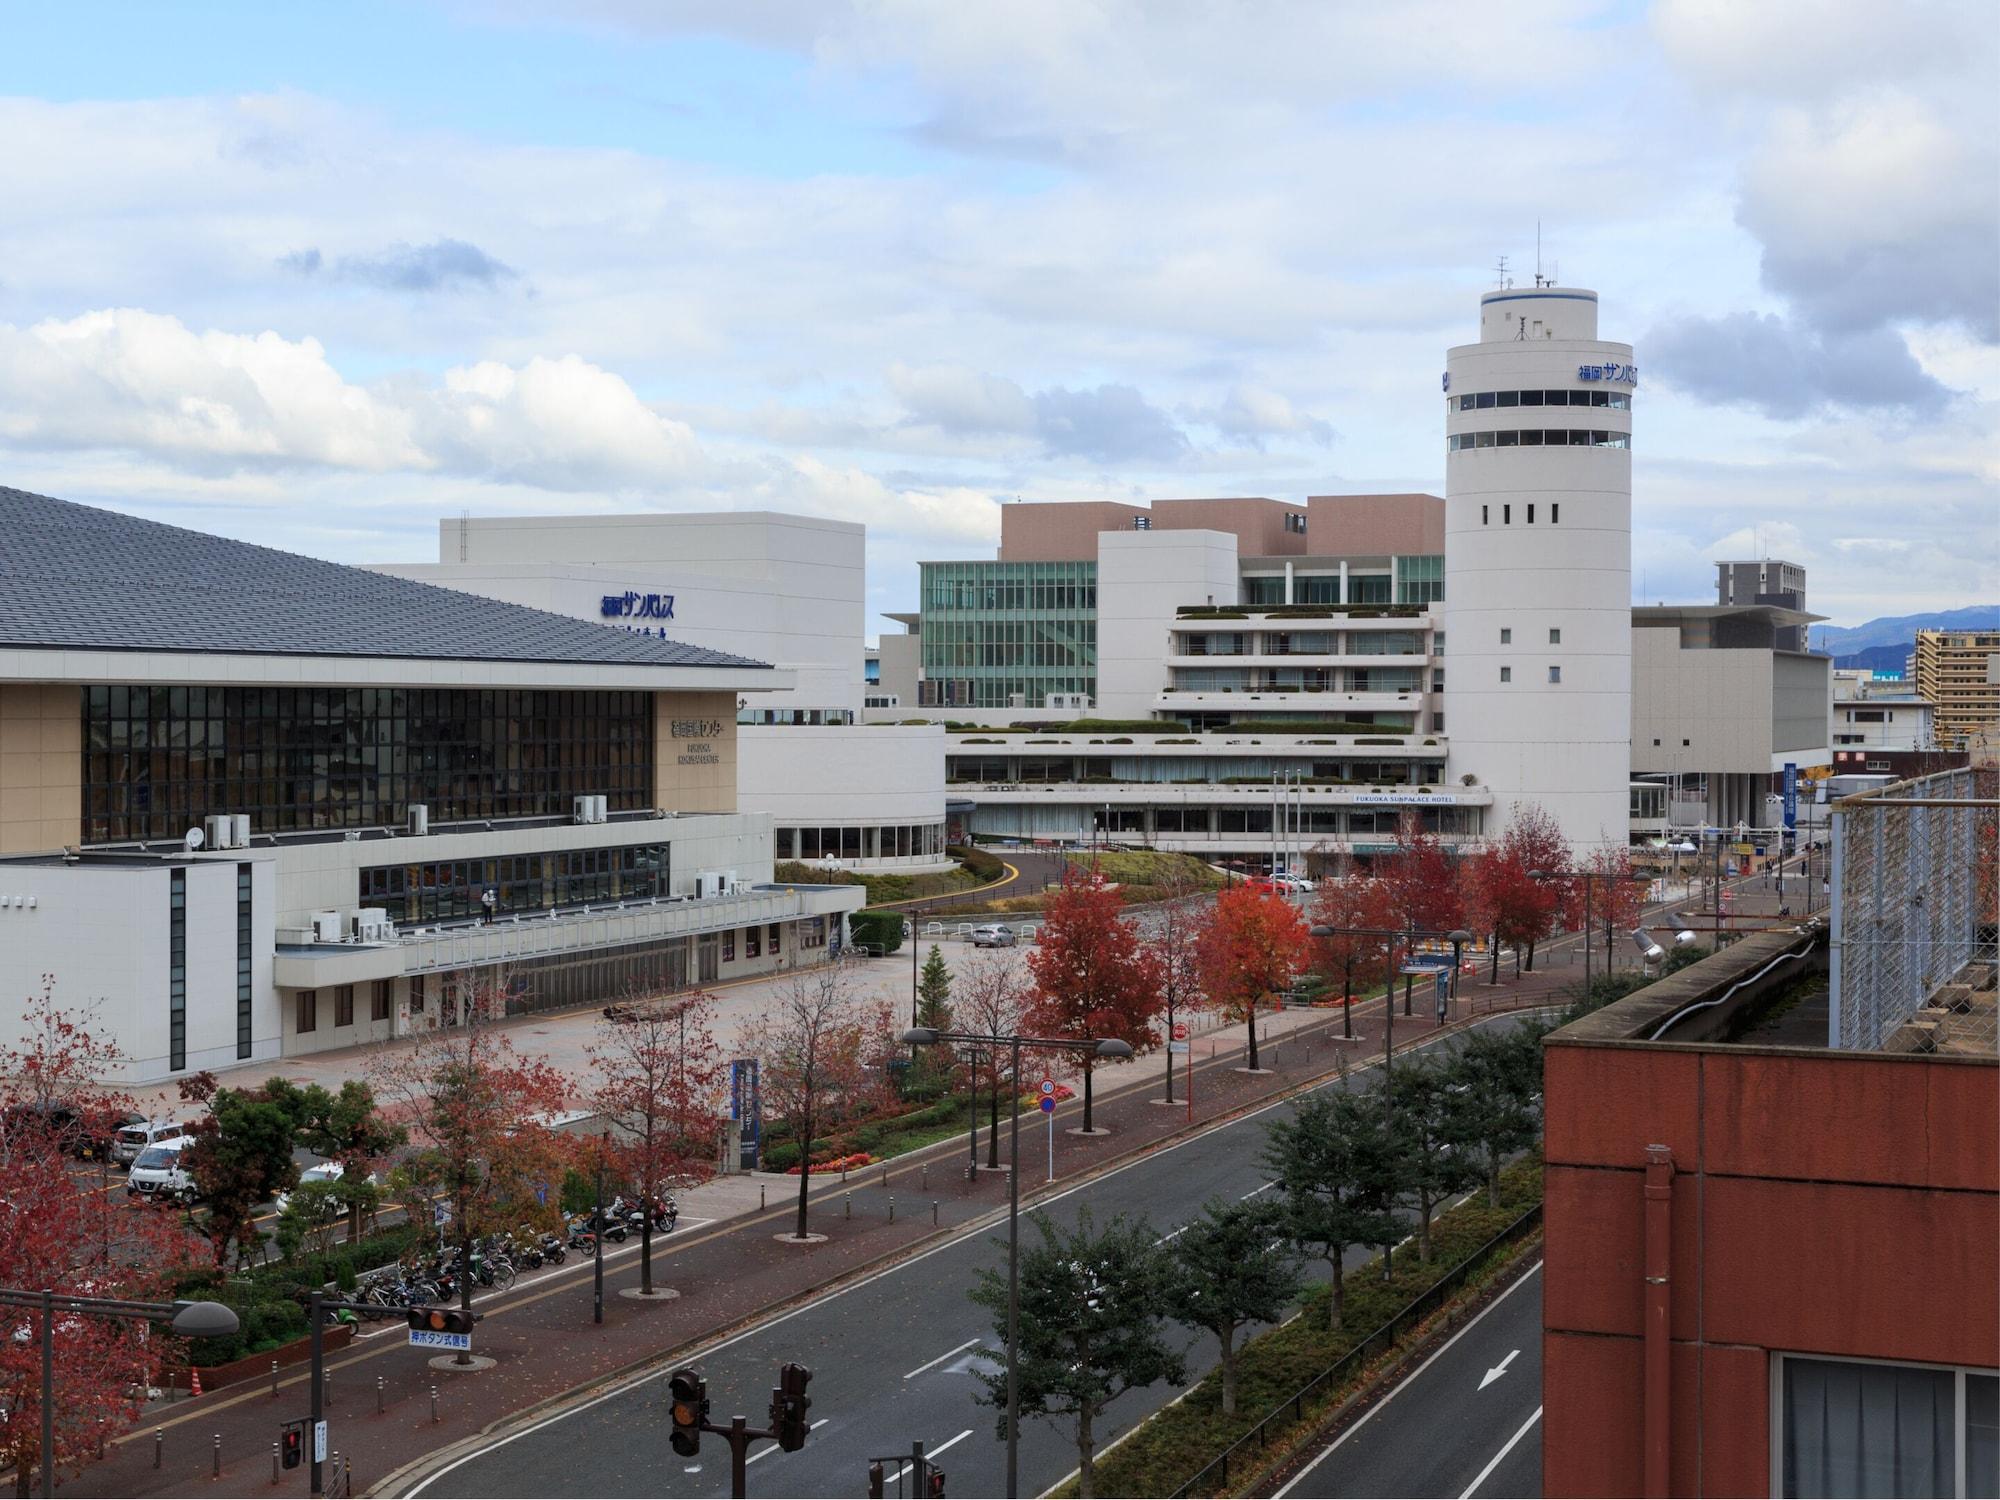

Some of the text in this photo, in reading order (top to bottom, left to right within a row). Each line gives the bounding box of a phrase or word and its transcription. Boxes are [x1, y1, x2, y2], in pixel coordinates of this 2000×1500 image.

[411, 1331, 469, 1348] 押ボタン式信号
